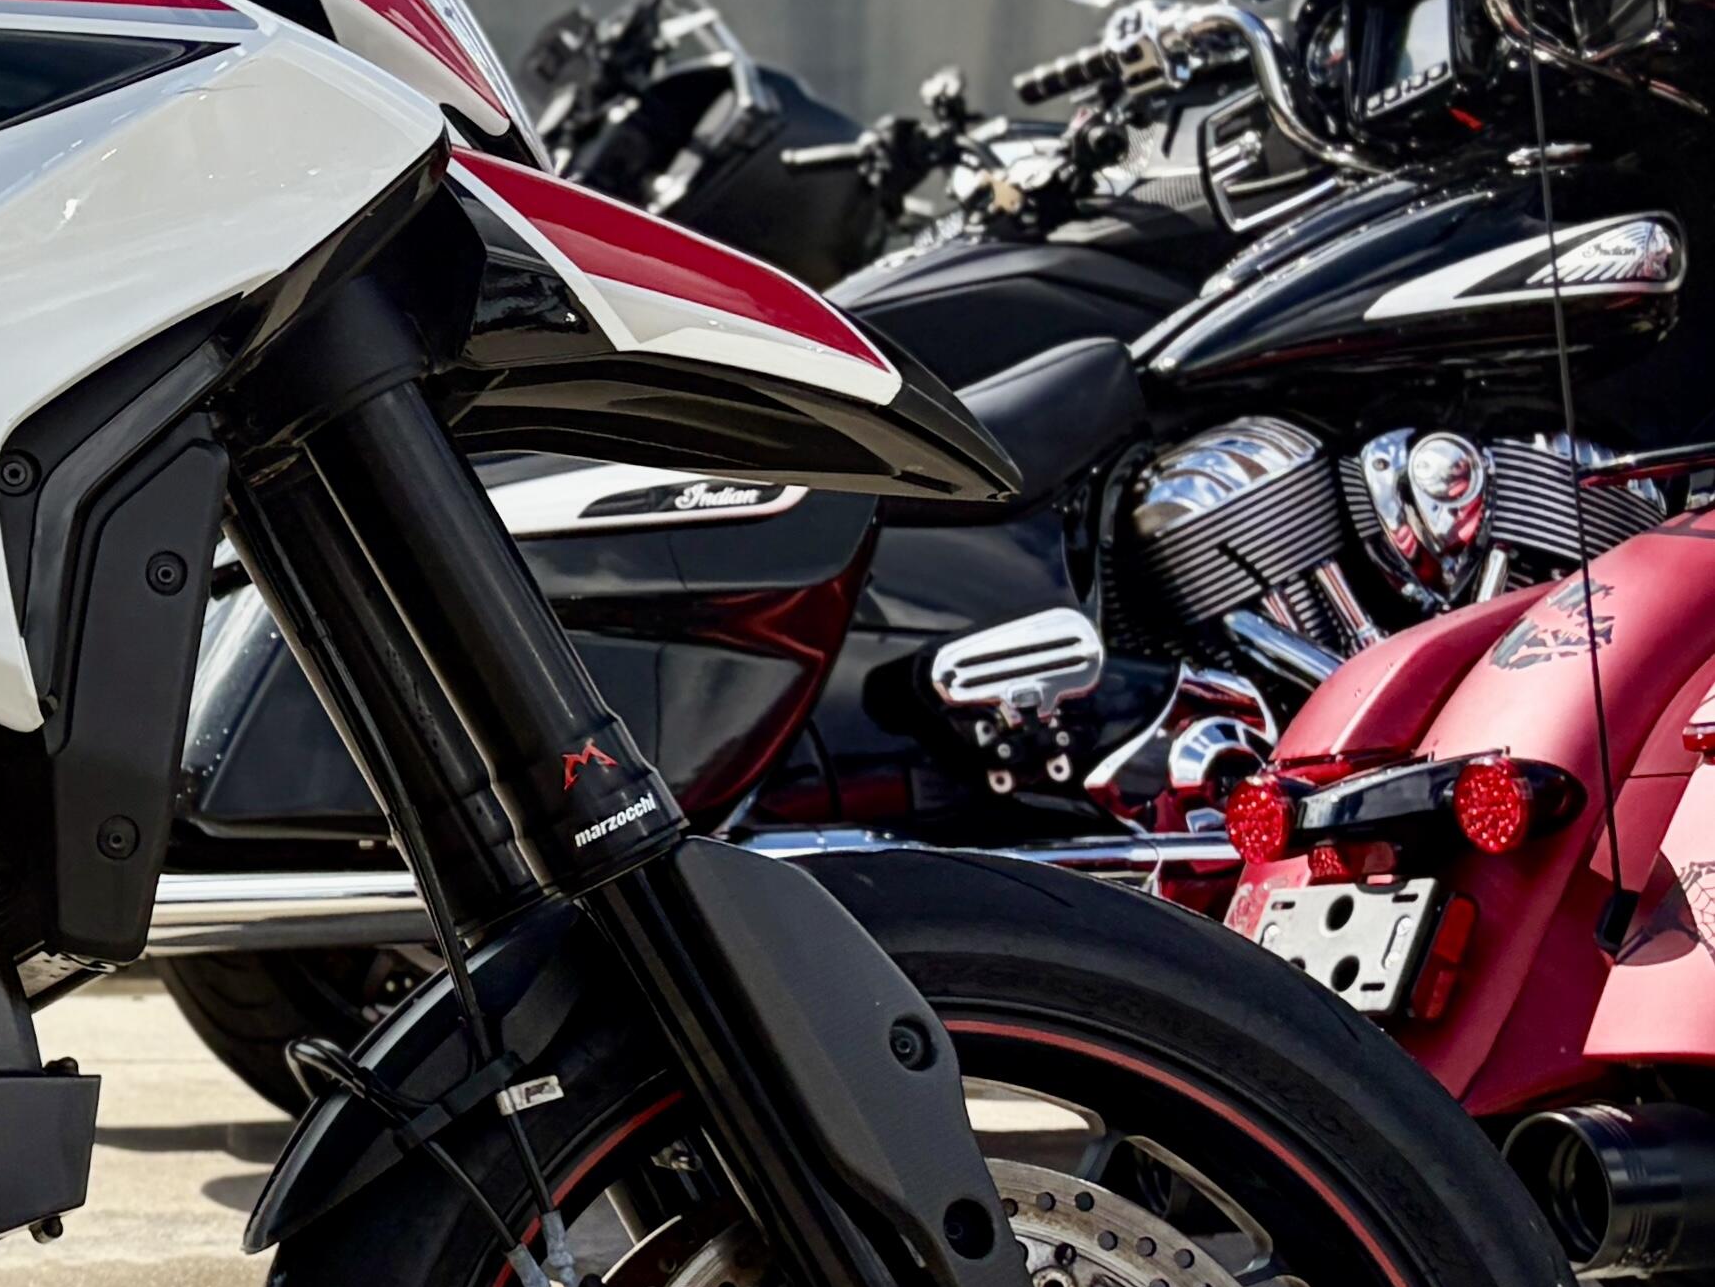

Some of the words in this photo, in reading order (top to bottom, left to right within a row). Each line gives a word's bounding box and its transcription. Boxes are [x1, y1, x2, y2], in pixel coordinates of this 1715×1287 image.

[1582, 245, 1637, 258] Indian
[674, 483, 761, 510] Indian
[574, 792, 657, 847] marzocchi
